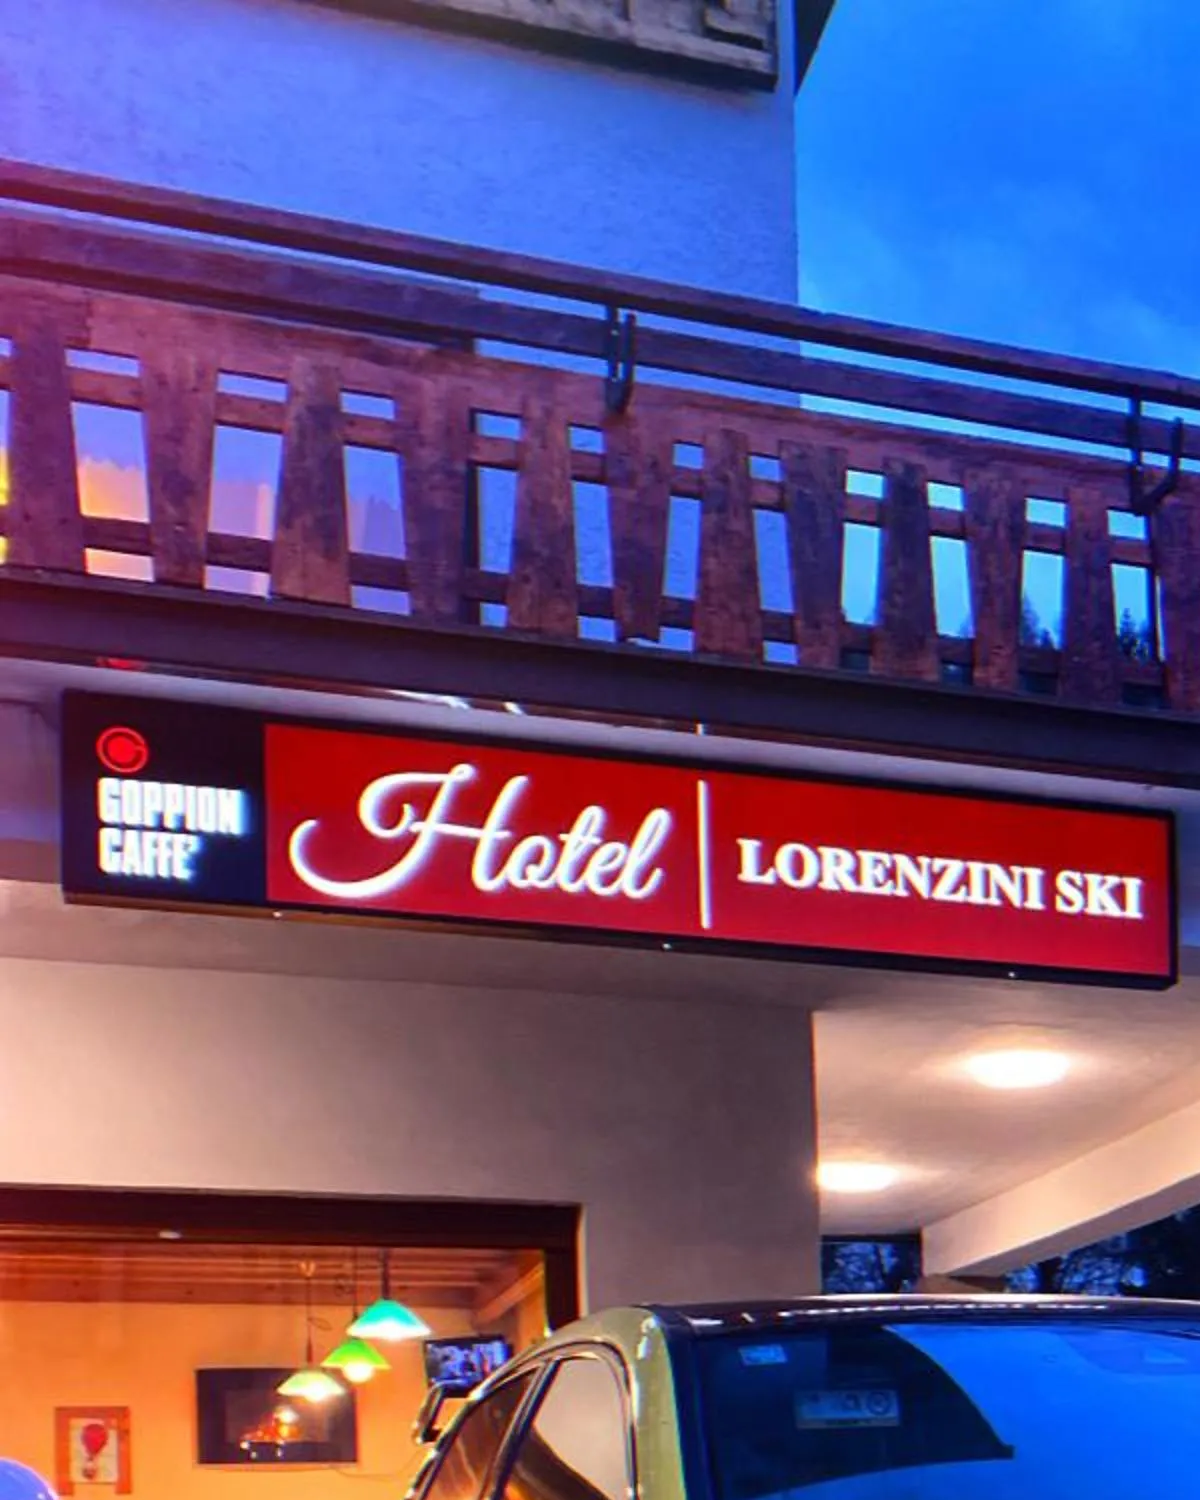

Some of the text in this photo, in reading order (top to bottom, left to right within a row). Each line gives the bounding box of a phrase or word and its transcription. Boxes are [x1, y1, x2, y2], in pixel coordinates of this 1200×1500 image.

[98, 777, 245, 836] GOPPION
[289, 763, 673, 899] Hotel
[737, 838, 1144, 919] LORENZINI SKI
